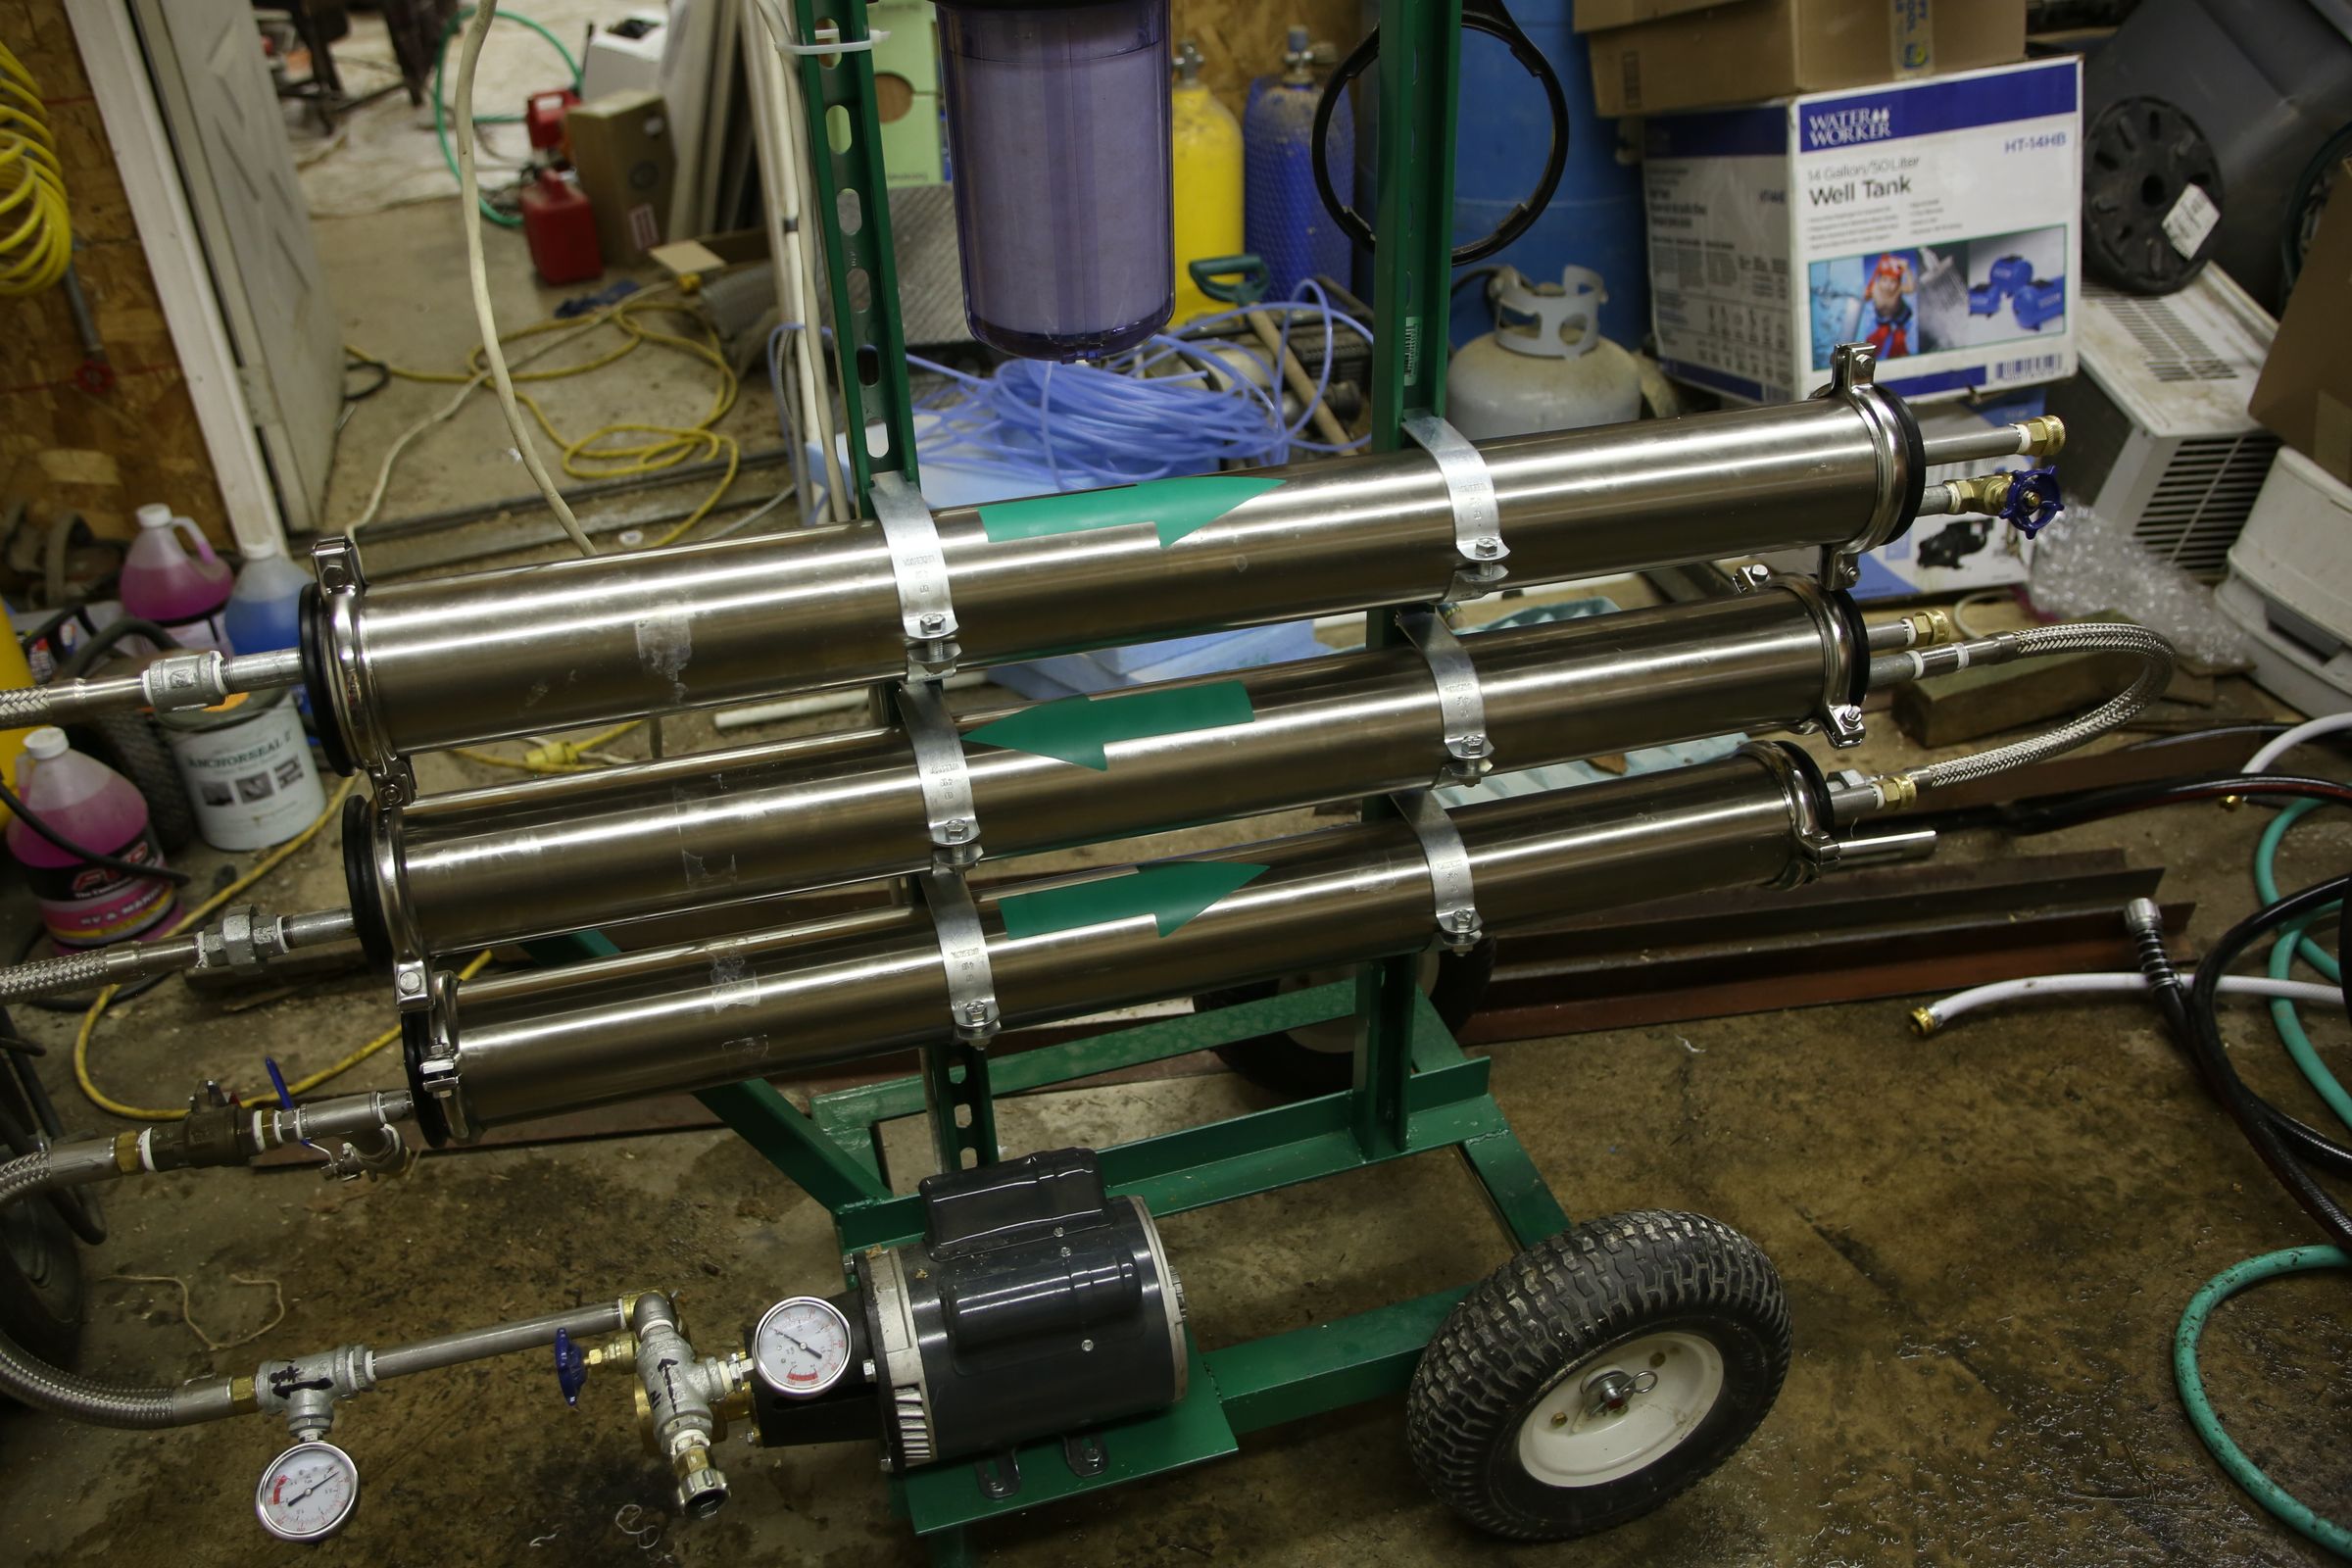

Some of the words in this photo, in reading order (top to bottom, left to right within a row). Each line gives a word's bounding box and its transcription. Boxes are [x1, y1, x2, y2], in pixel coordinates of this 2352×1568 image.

[1809, 107, 1873, 131] WATER
[1809, 122, 1892, 148] WORKER
[1809, 181, 1855, 207] Well
[1862, 174, 1912, 199] Tank
